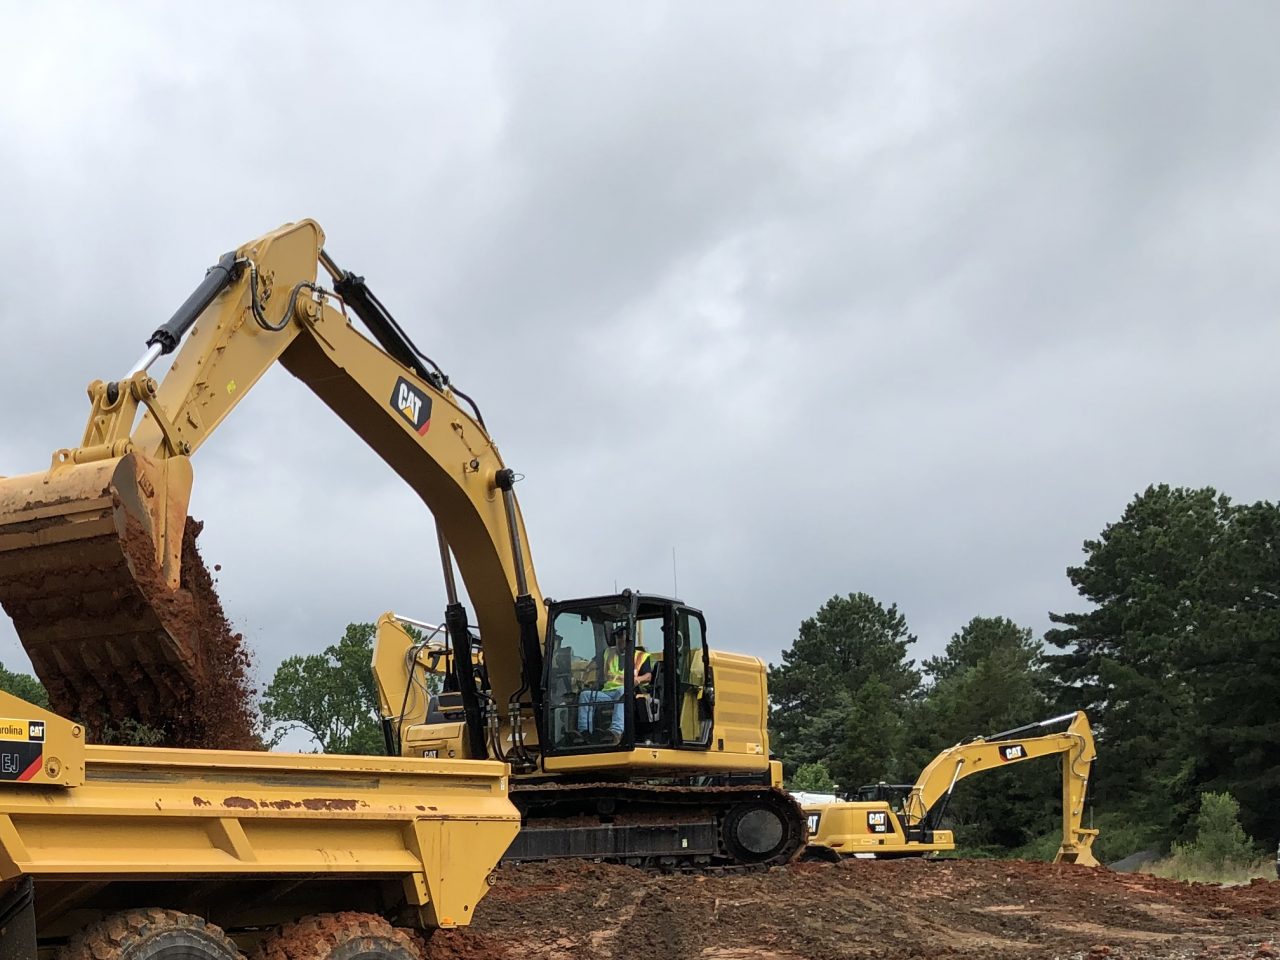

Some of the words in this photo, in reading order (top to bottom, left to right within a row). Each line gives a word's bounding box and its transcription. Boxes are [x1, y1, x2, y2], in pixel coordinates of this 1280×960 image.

[398, 383, 422, 425] CAT
[29, 725, 44, 737] CAT
[424, 750, 438, 759] CAT
[1006, 745, 1022, 760] CAT
[1, 753, 19, 773] EJ
[807, 815, 819, 833] AT
[868, 813, 885, 825] CAT
